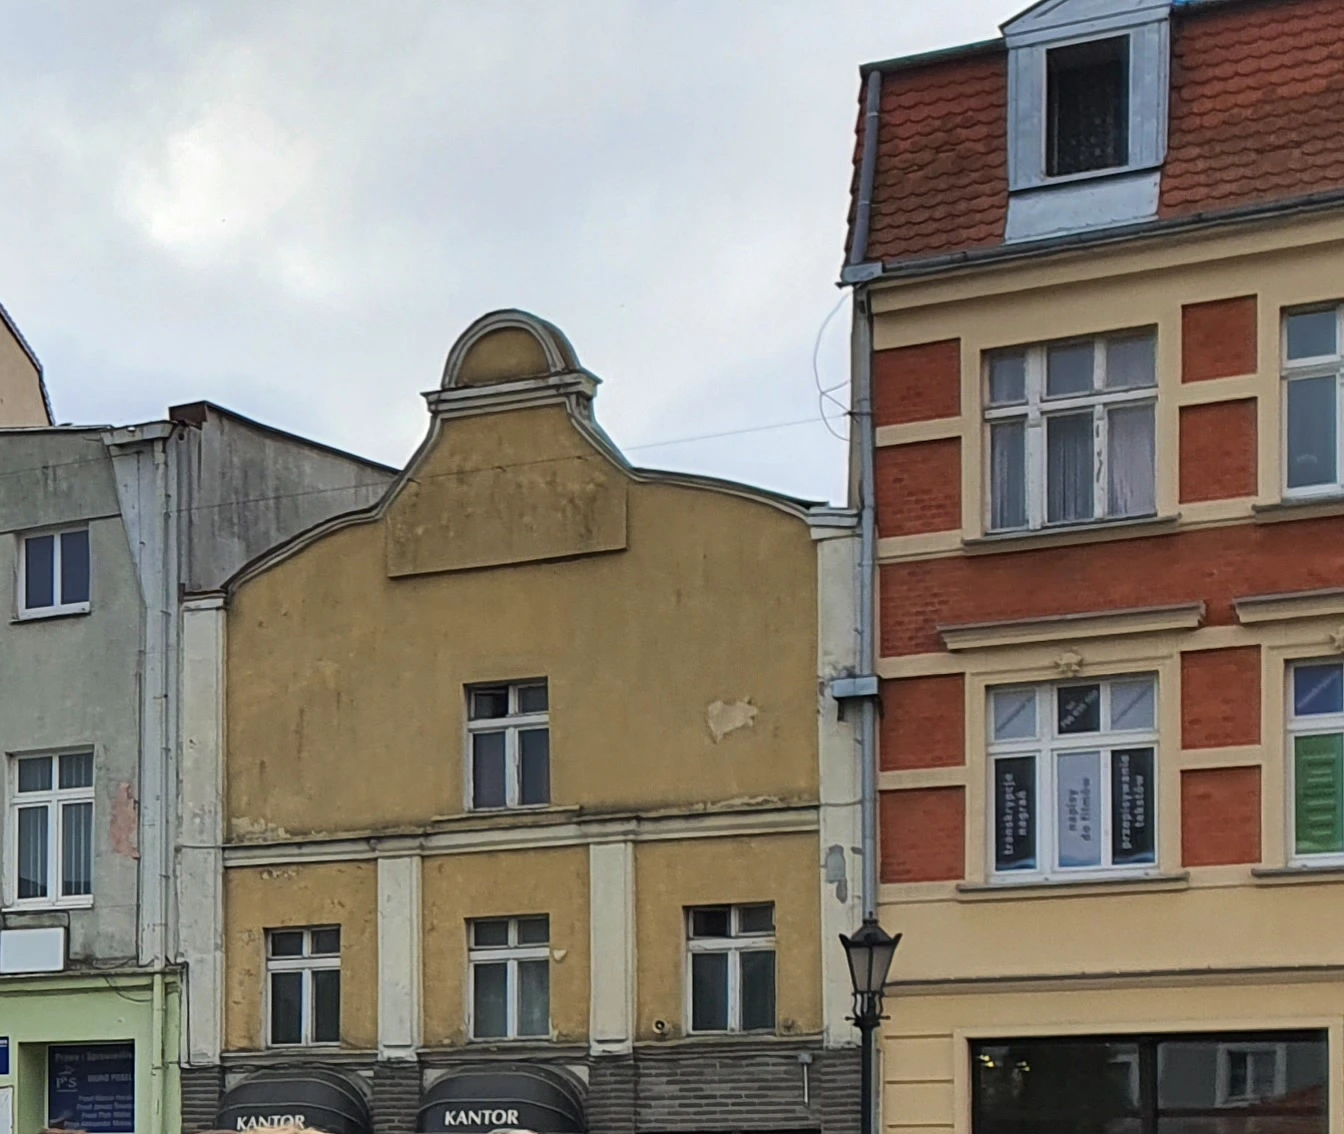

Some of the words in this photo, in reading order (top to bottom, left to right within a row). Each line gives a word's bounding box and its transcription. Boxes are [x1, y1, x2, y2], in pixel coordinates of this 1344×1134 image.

[1002, 773, 1016, 855] transkrypcje
[236, 1115, 305, 1131] KANTOR
[444, 1109, 519, 1126] KANTOR
